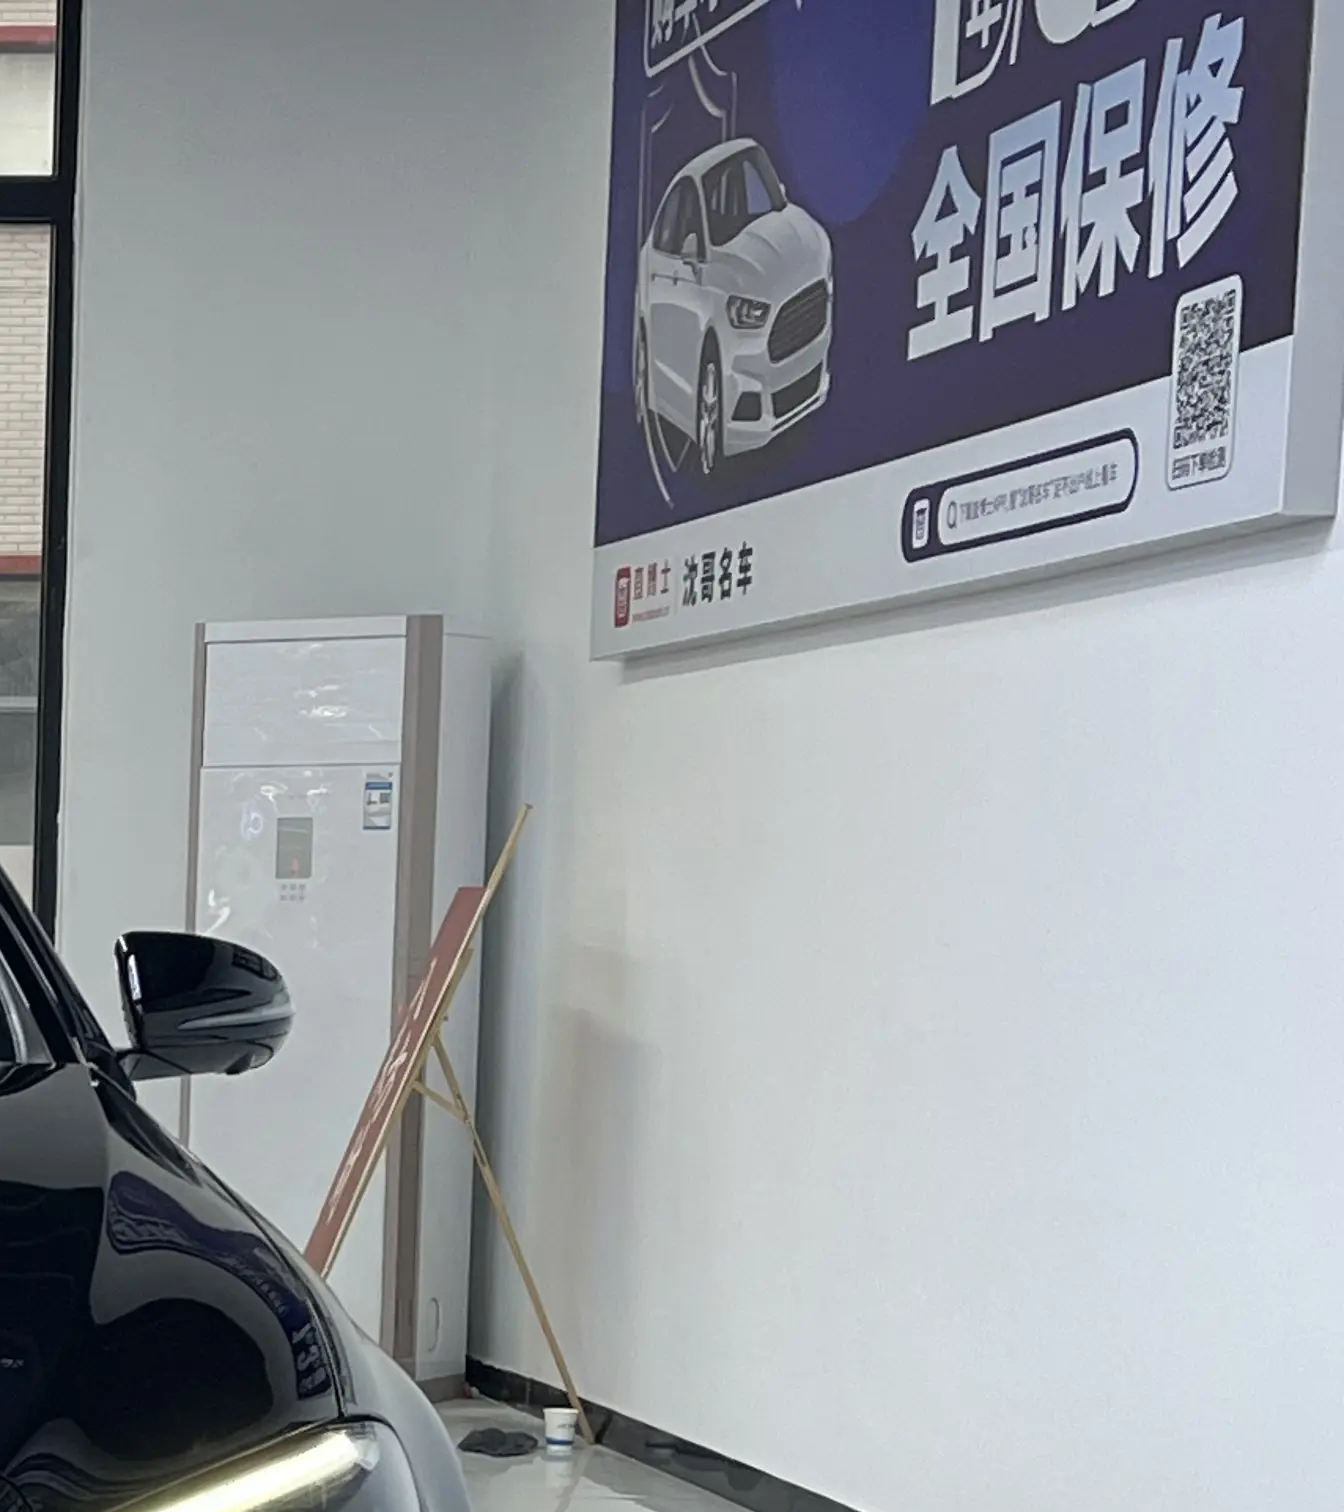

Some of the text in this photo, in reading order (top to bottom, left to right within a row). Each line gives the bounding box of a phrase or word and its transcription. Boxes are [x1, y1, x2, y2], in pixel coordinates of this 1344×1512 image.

[908, 13, 1244, 361] 全国保修
[682, 541, 753, 606] 沈哥名车
